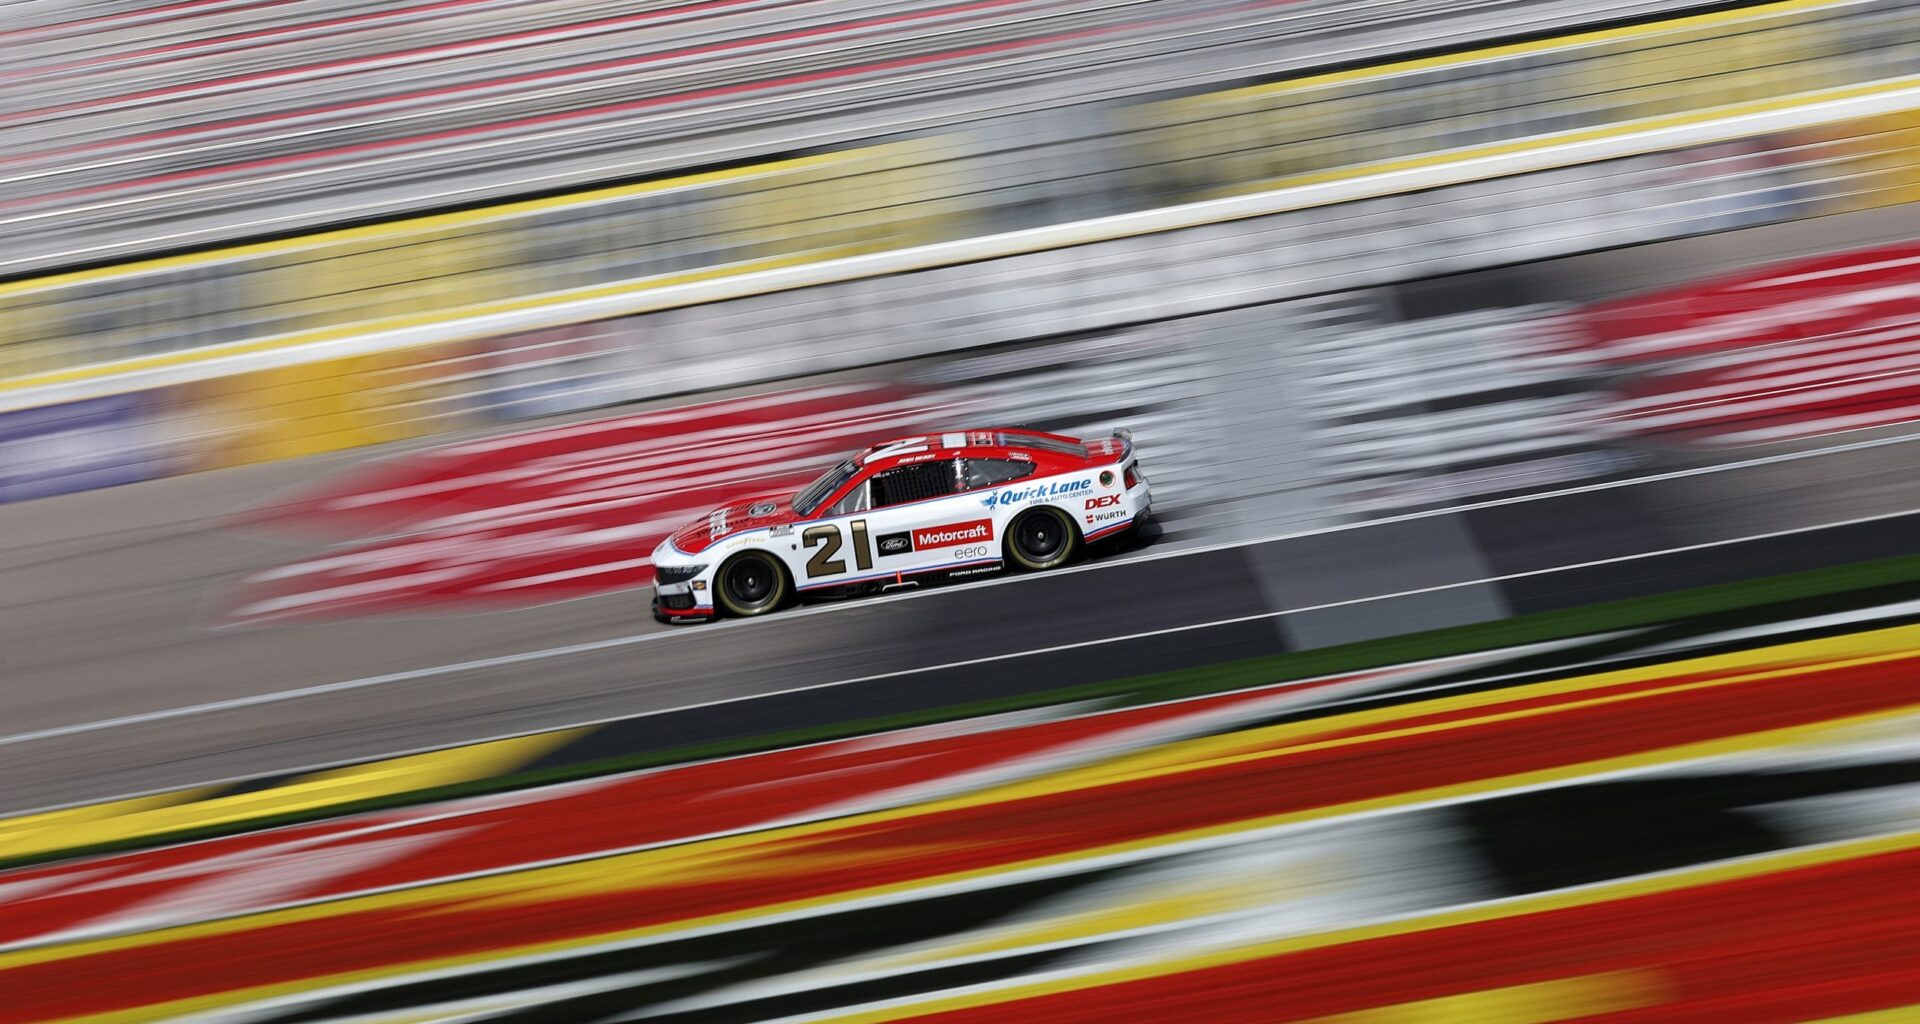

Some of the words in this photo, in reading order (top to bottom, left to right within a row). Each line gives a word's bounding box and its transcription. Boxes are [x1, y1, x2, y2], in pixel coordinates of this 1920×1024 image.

[1000, 485, 1048, 505] Quick
[1049, 478, 1092, 496] Lane
[1030, 496, 1044, 505] TIRE
[1050, 493, 1068, 502] AUTO
[1068, 488, 1094, 499] CENTER
[1085, 493, 1121, 511] DEX
[918, 525, 988, 545] Motorcraft
[802, 518, 874, 579] 21
[884, 538, 905, 550] Ford
[954, 545, 988, 560] eero
[949, 569, 972, 577] FORD
